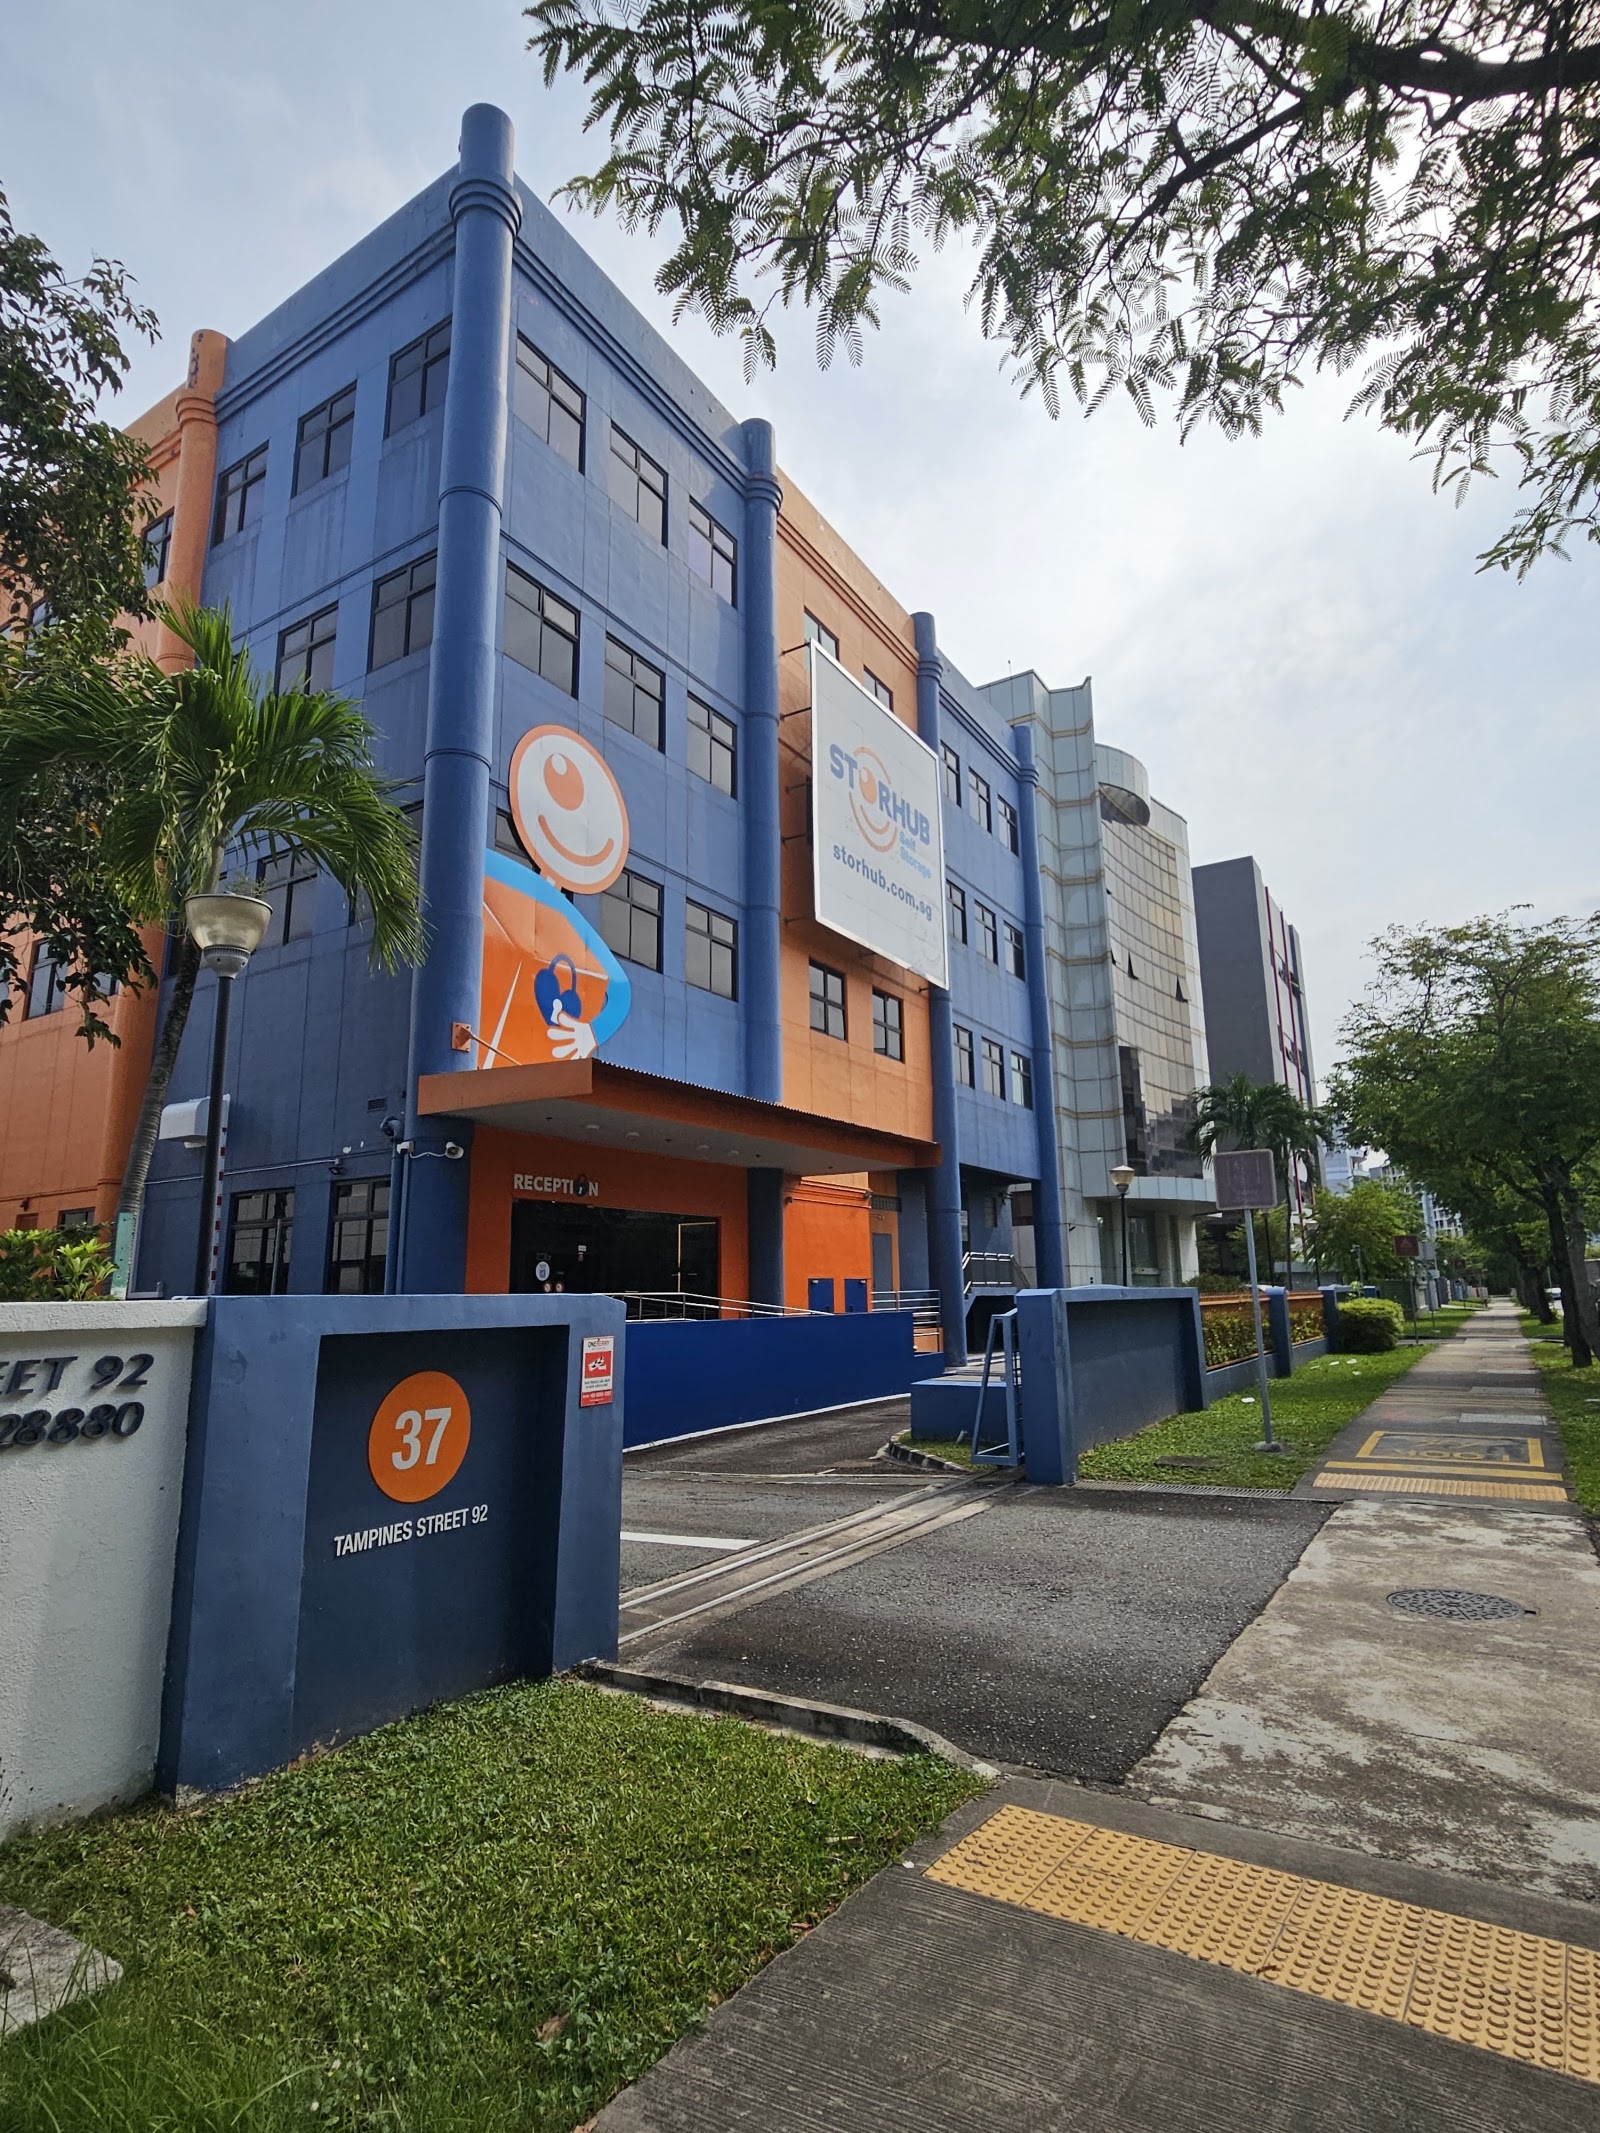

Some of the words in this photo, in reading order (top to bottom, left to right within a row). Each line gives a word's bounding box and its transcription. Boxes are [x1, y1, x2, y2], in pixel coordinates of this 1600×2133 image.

[829, 744, 931, 846] STORHUB
[899, 831, 916, 852] Self
[899, 848, 932, 879] Storage
[833, 844, 932, 922] storhub.com.sg
[91, 1353, 155, 1390] 92
[392, 1407, 452, 1470] 37
[334, 1520, 413, 1557] TAMPINES
[416, 1508, 469, 1537] STREET
[472, 1504, 489, 1524] 92
